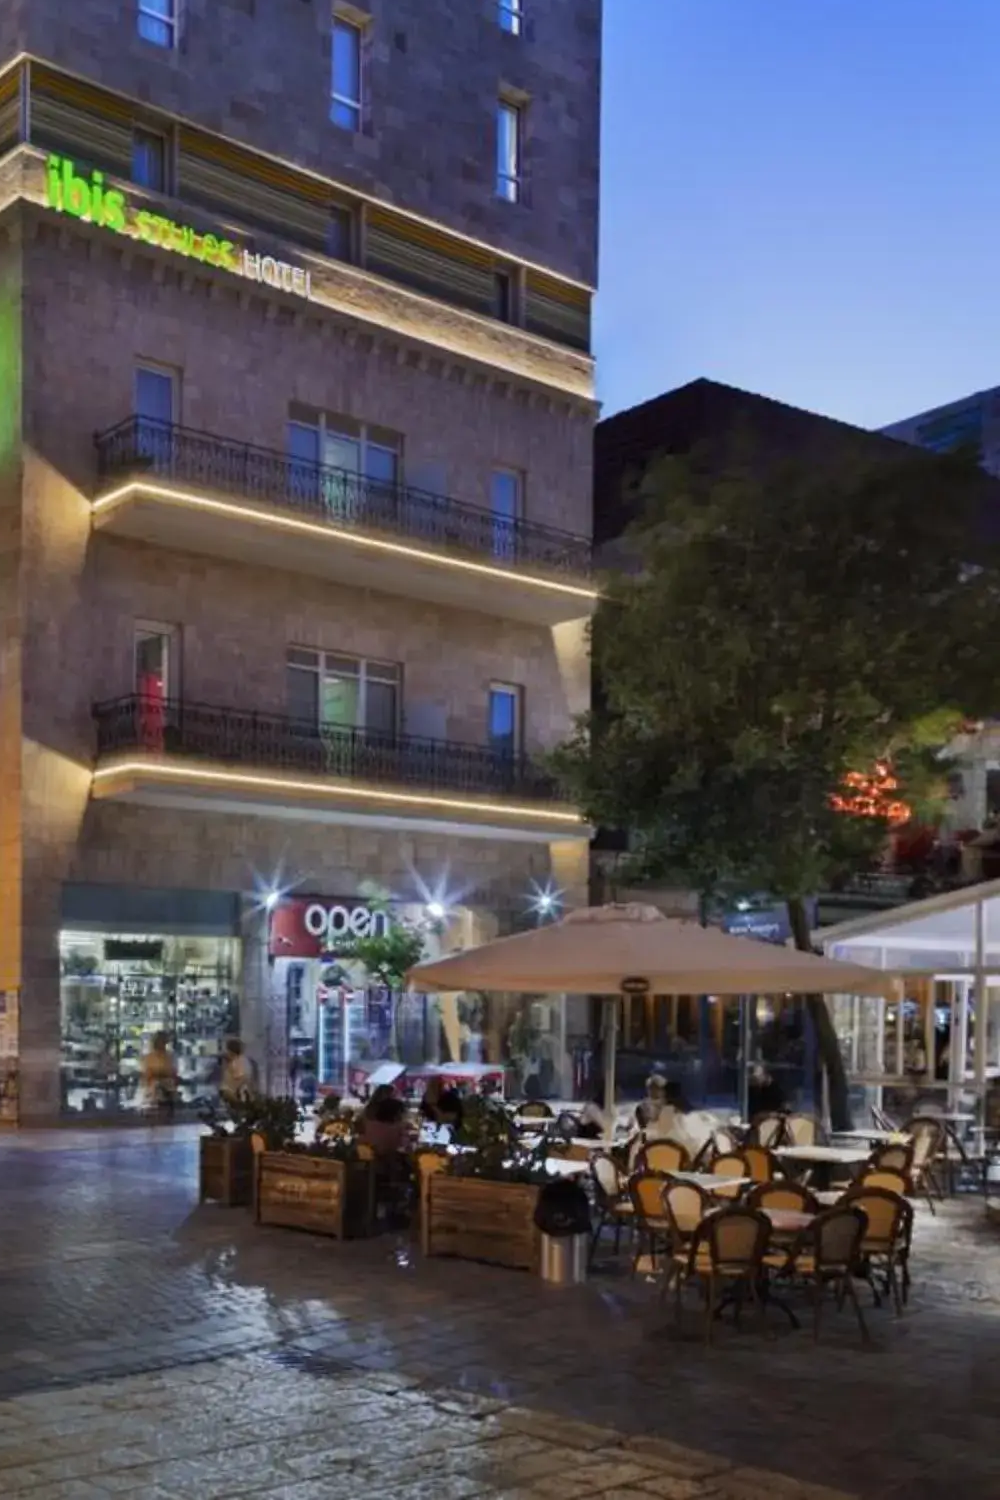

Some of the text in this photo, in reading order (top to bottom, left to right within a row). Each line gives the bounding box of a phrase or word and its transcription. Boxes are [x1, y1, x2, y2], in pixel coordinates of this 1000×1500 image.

[45, 153, 125, 230] ibis
[242, 249, 312, 299] HOTEL
[304, 904, 388, 952] open
